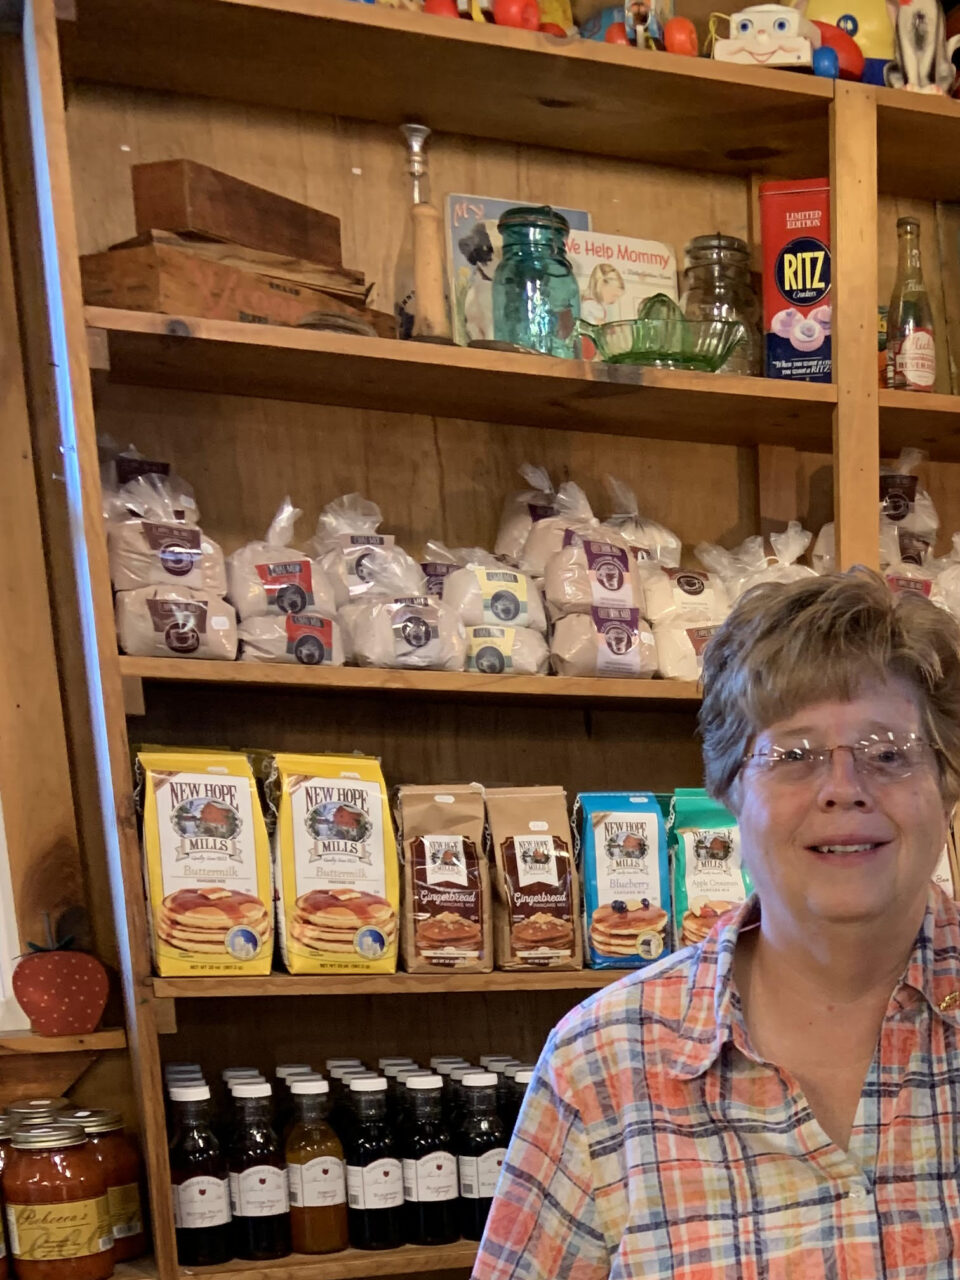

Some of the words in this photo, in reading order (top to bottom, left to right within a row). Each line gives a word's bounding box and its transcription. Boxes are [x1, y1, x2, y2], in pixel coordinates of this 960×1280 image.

[786, 210, 822, 221] LIMITED
[787, 219, 821, 229] EDITION
[585, 240, 613, 259] Help
[617, 245, 670, 269] Mommy
[784, 251, 826, 291] RITZ
[169, 782, 201, 811] NEW
[204, 783, 240, 813] HOPE
[304, 786, 334, 814] NEW
[336, 788, 370, 816] HOPE
[604, 822, 624, 839] NEW
[626, 822, 648, 840] HOPE
[189, 838, 228, 851] MILLS
[322, 841, 359, 854] MILLS
[609, 879, 649, 890] Blueberry
[420, 889, 477, 905] Gingerbread
[513, 891, 567, 907] Gingerbread
